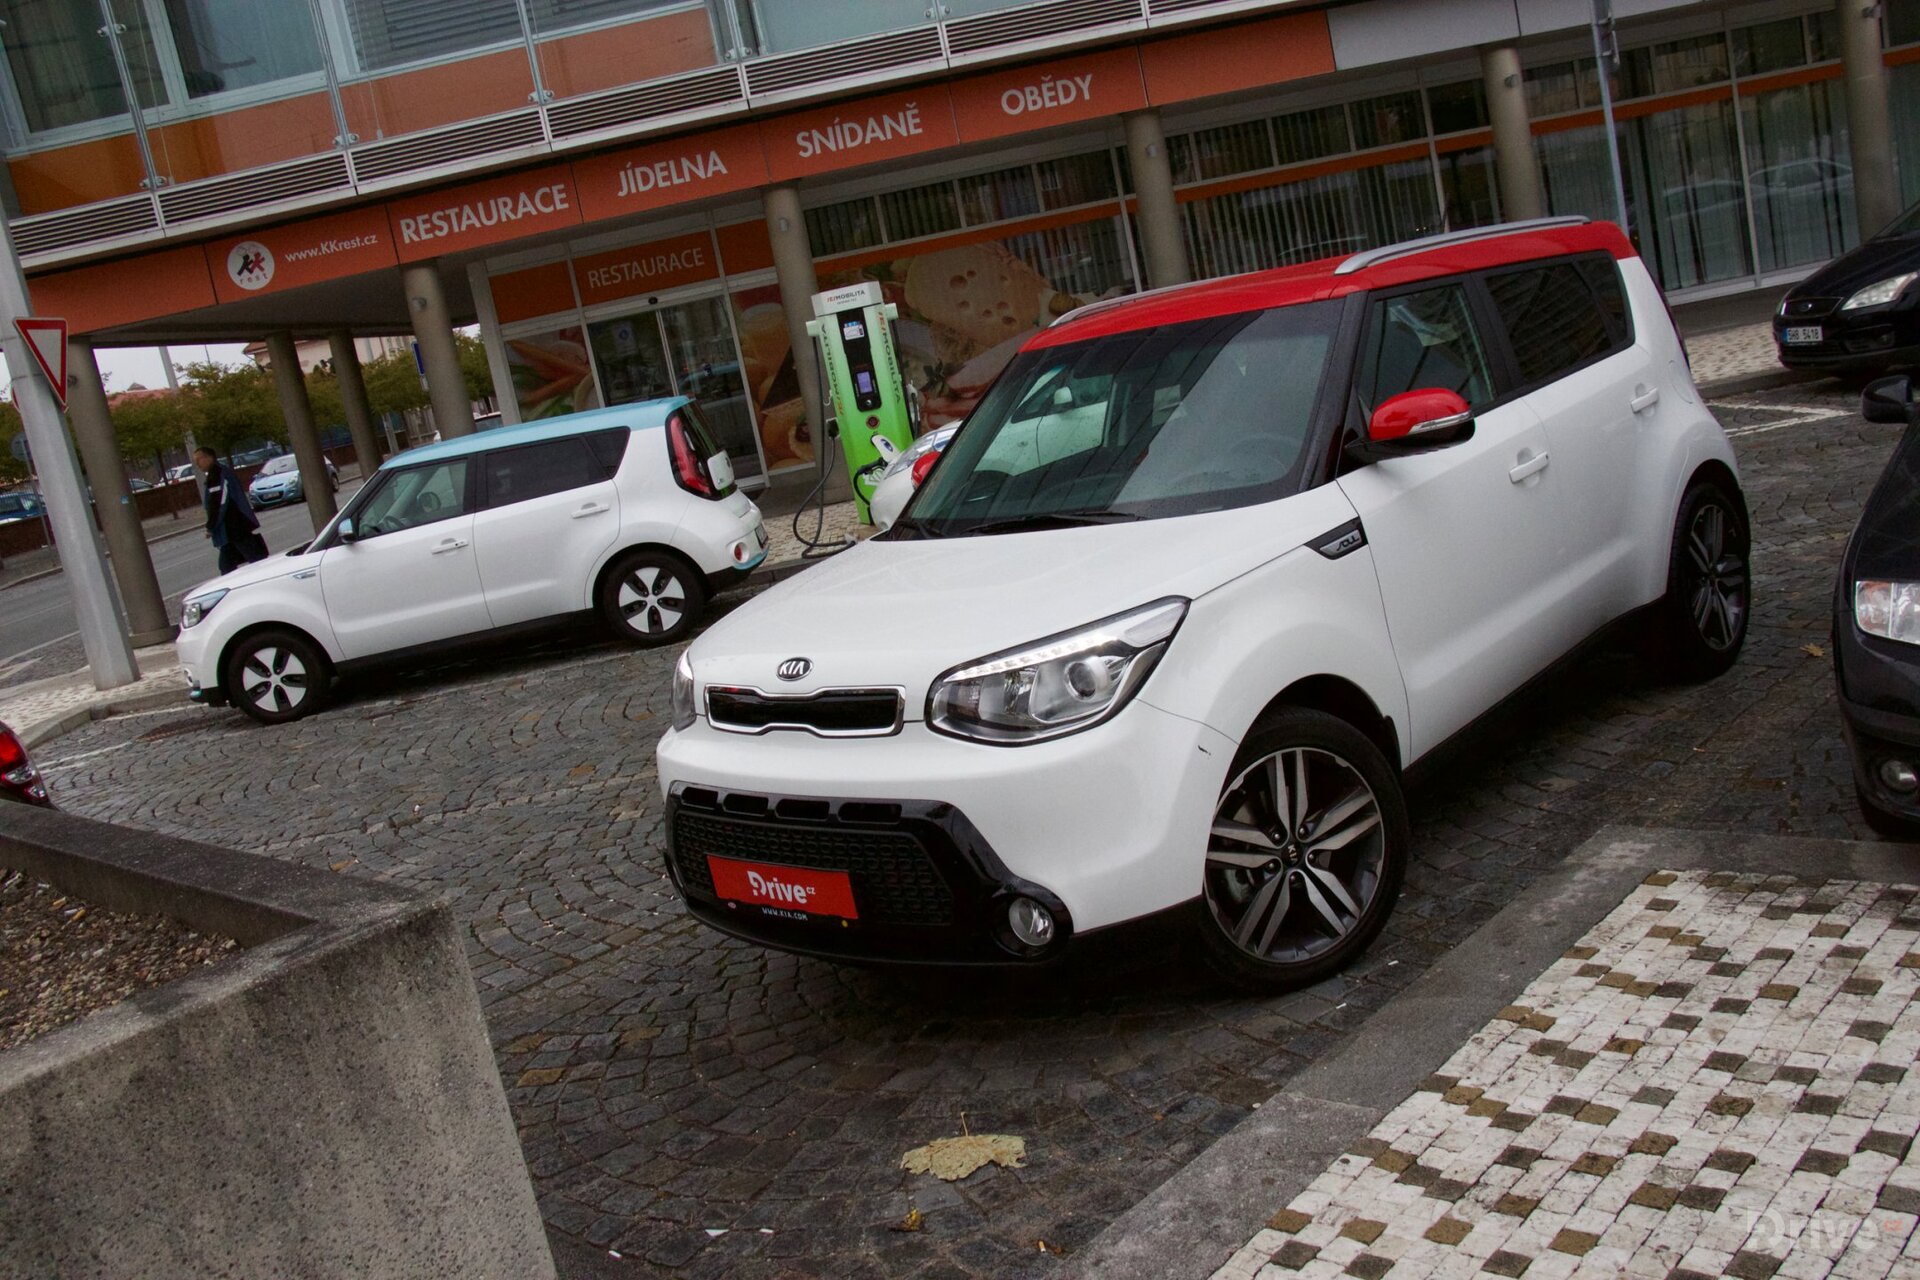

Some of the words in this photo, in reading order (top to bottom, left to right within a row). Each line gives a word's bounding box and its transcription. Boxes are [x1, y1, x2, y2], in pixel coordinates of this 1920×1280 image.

[1001, 75, 1092, 115] OBĚDY
[796, 102, 923, 158] SNÍDANĚ
[617, 150, 729, 197] JÍDELNA
[400, 184, 570, 244] RESTAURACE
[285, 234, 379, 263] www.KKrest.cz
[587, 247, 705, 288] RESTAURACE
[779, 660, 805, 675] KIA
[747, 870, 808, 904] Drive
[762, 907, 808, 921] WWW.KIA.COM
